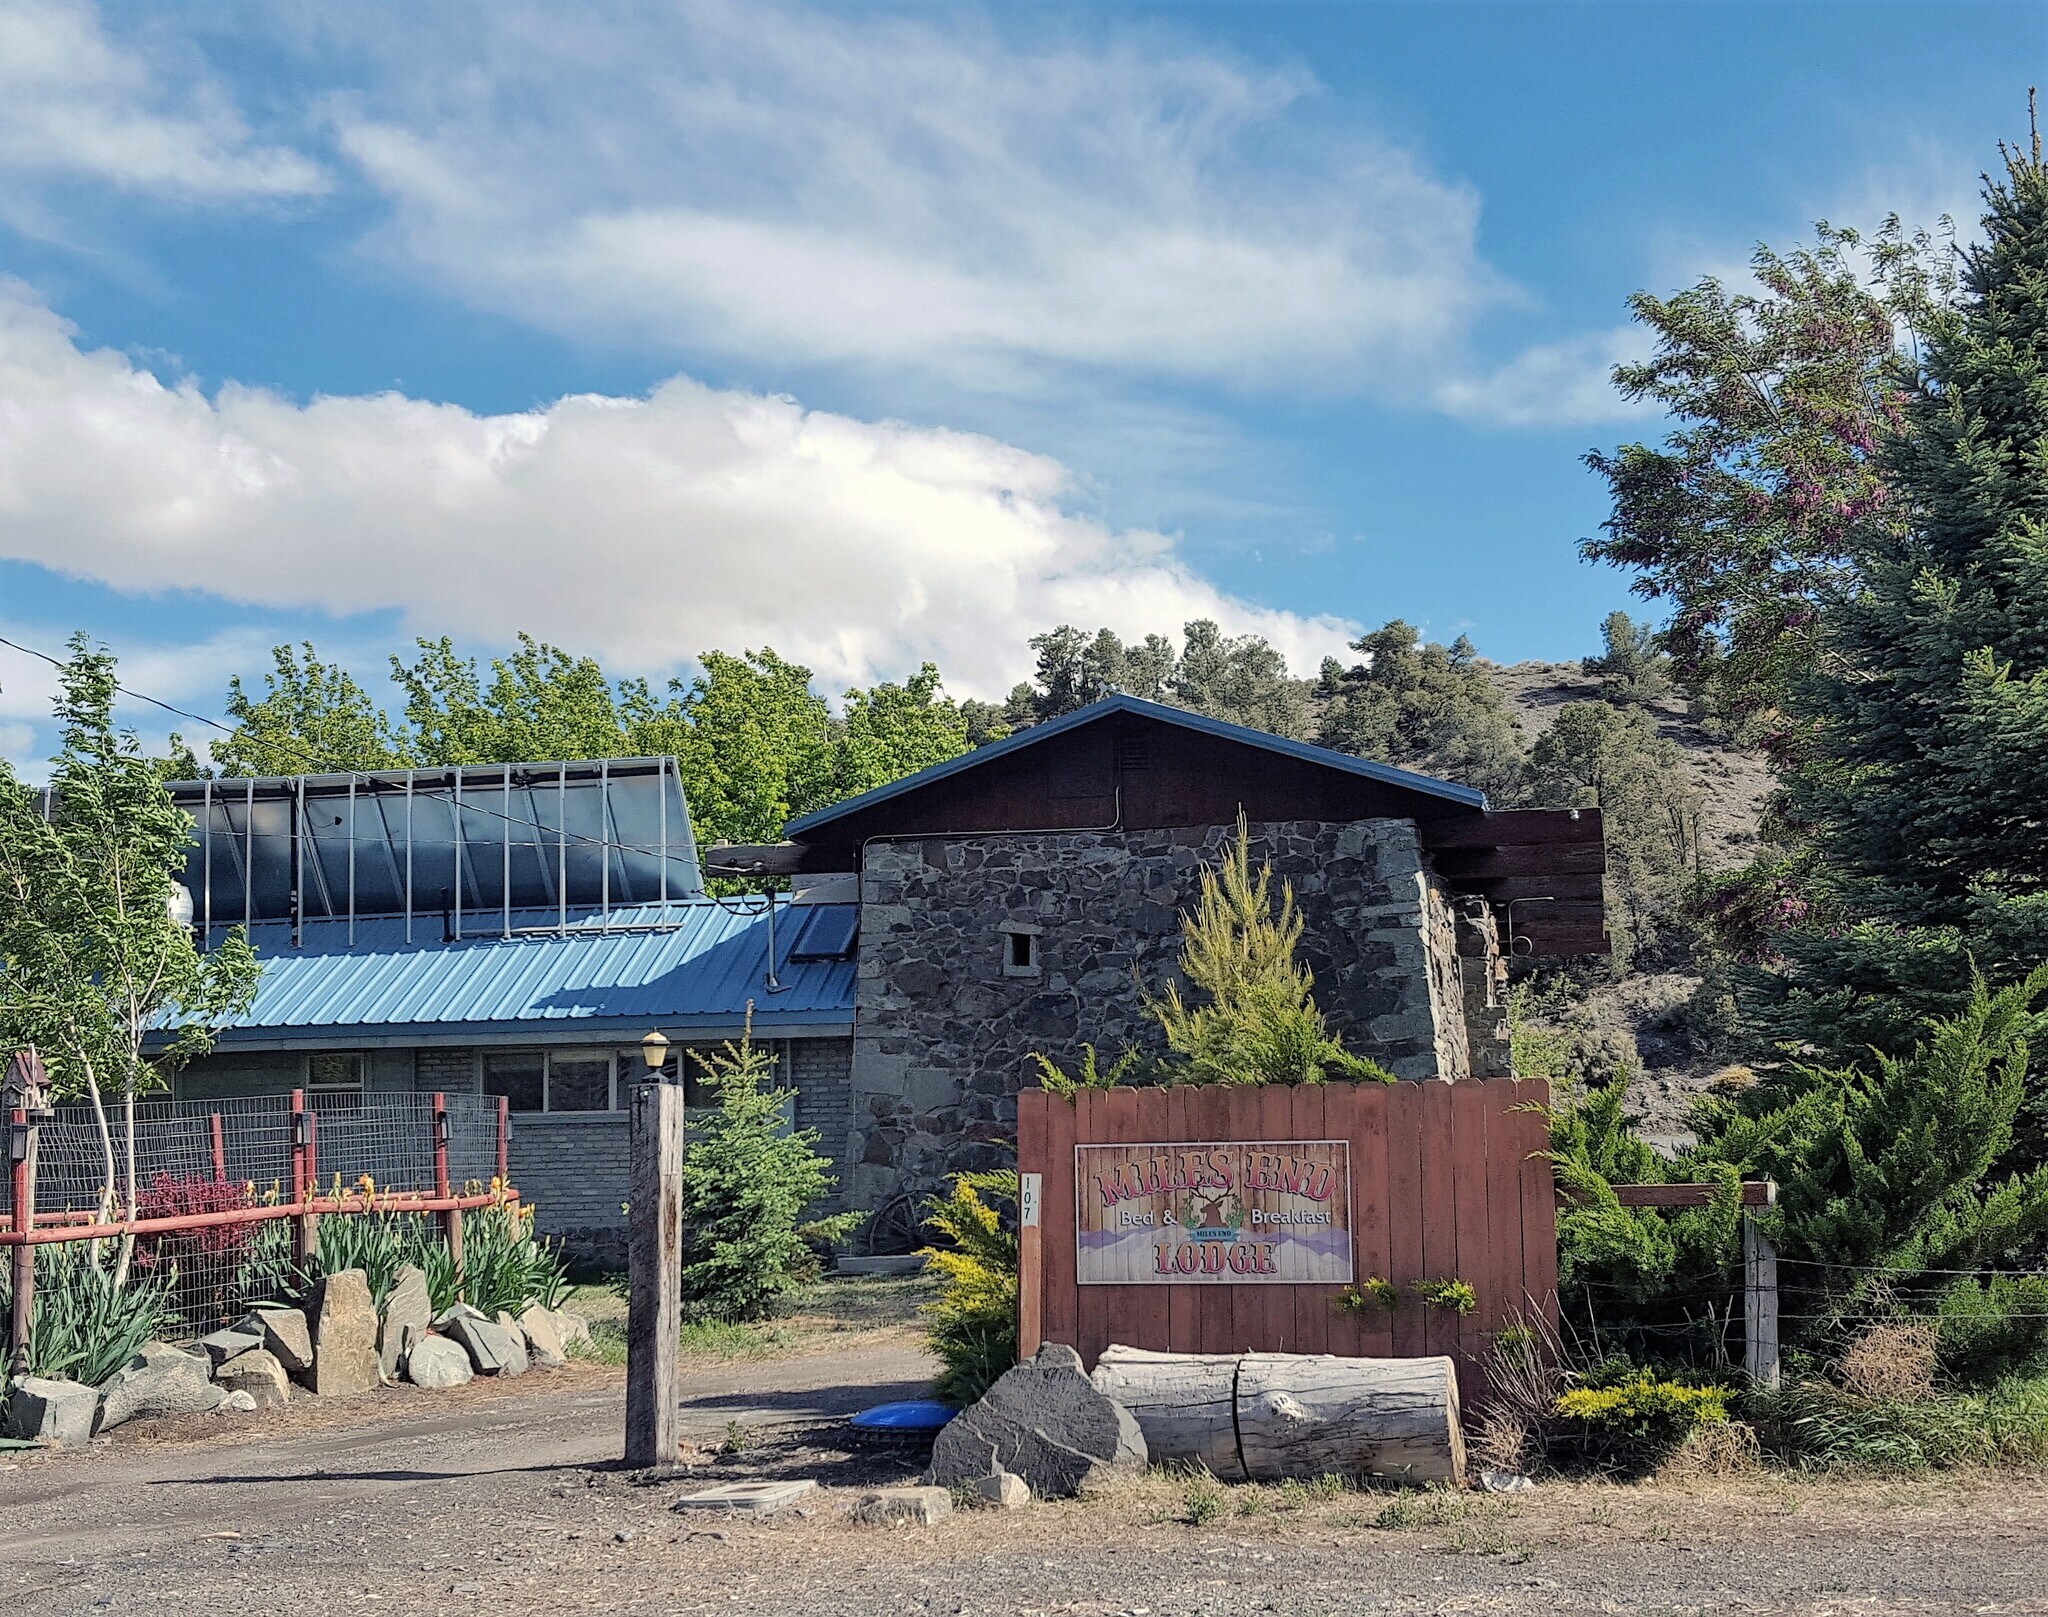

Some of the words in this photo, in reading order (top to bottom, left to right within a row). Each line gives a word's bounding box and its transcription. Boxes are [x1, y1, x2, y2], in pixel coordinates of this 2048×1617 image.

[1095, 1149, 1235, 1207] MILES
[1245, 1151, 1339, 1202] END
[1120, 1210, 1154, 1226] Bed
[1163, 1209, 1178, 1226] &
[1251, 1209, 1331, 1226] Breakfast
[1154, 1240, 1278, 1275] LODGE
